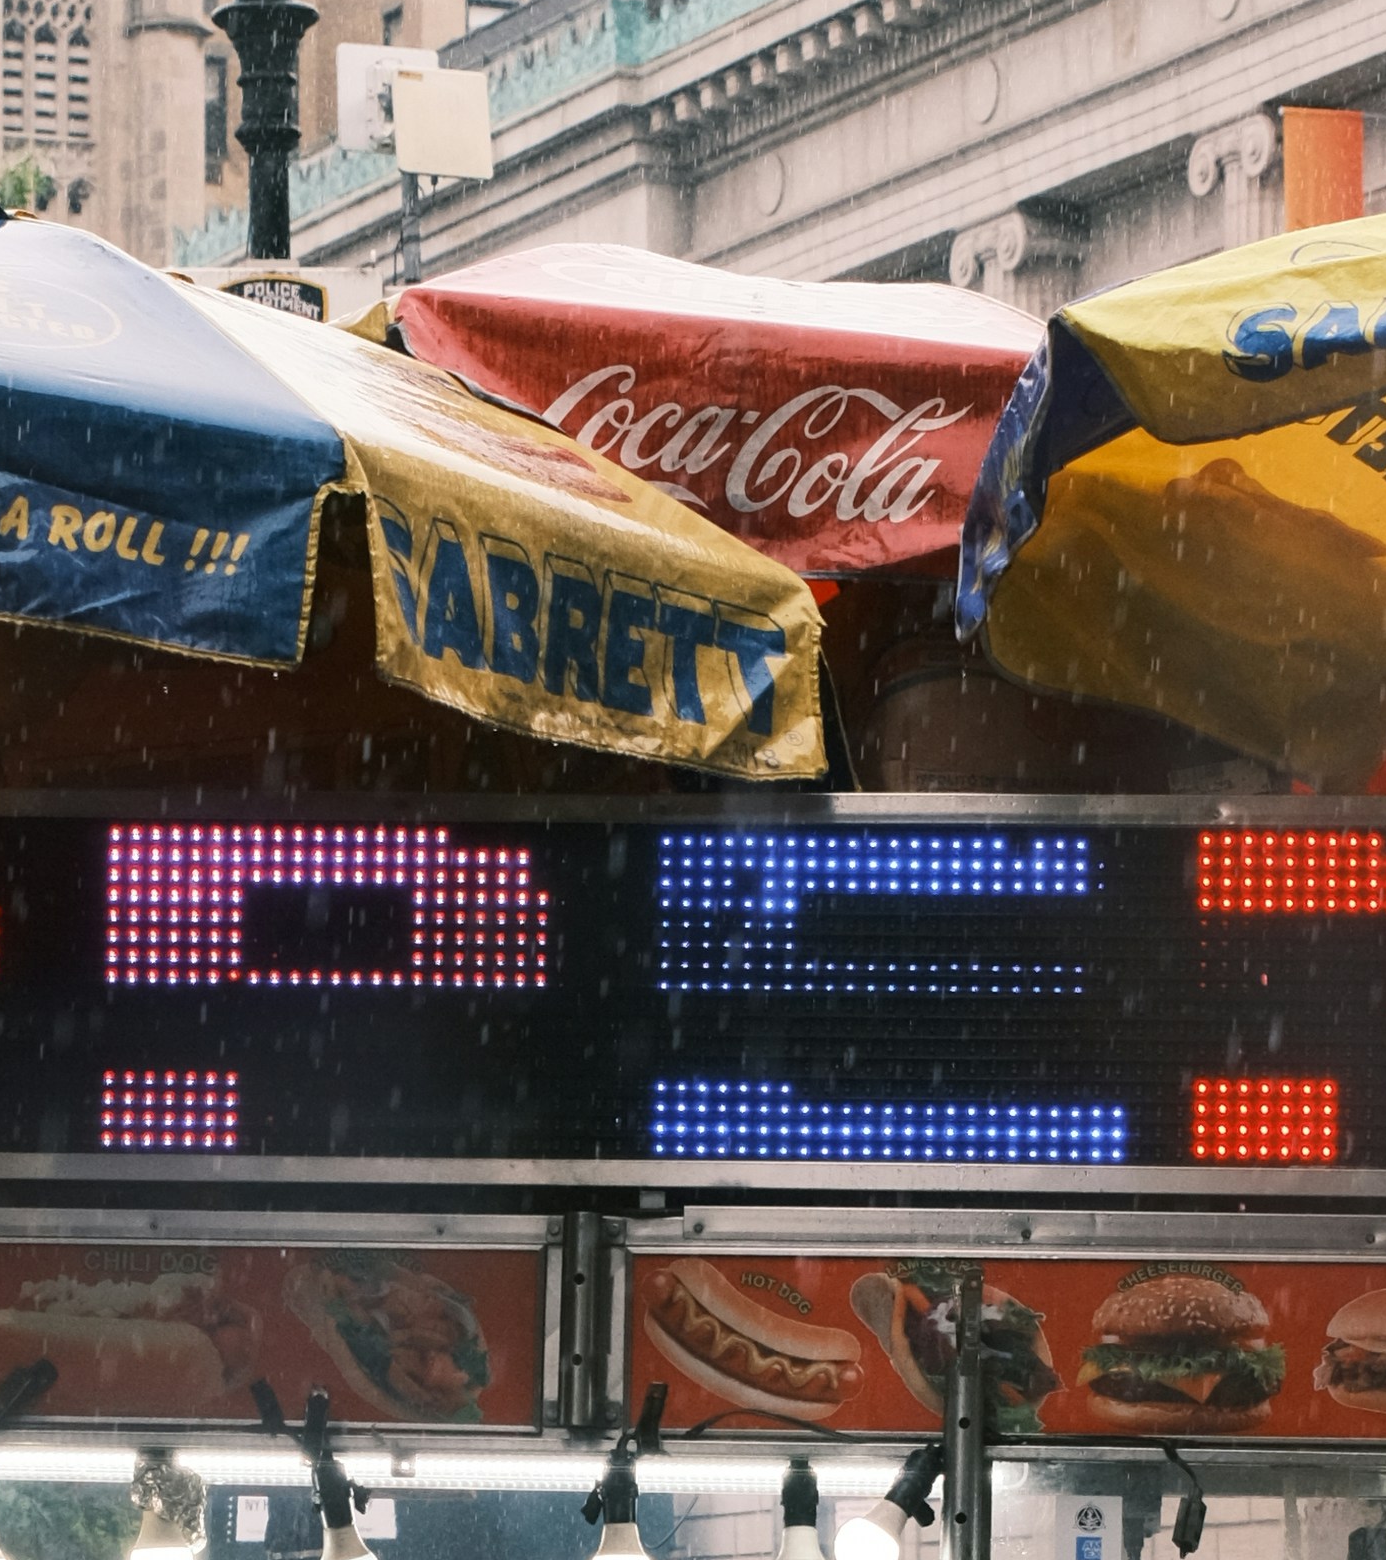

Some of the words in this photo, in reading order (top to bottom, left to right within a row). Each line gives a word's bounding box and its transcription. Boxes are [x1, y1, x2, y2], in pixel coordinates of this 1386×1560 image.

[244, 282, 300, 298] POLICE
[542, 365, 971, 523] Coca-Cola
[45, 503, 168, 567] ROLL
[84, 1250, 150, 1272] CHILI
[160, 1253, 218, 1273] DOG
[1116, 1261, 1245, 1295] CHEESEBURGER
[740, 1271, 777, 1292] HOT
[778, 1283, 813, 1315] DOG
